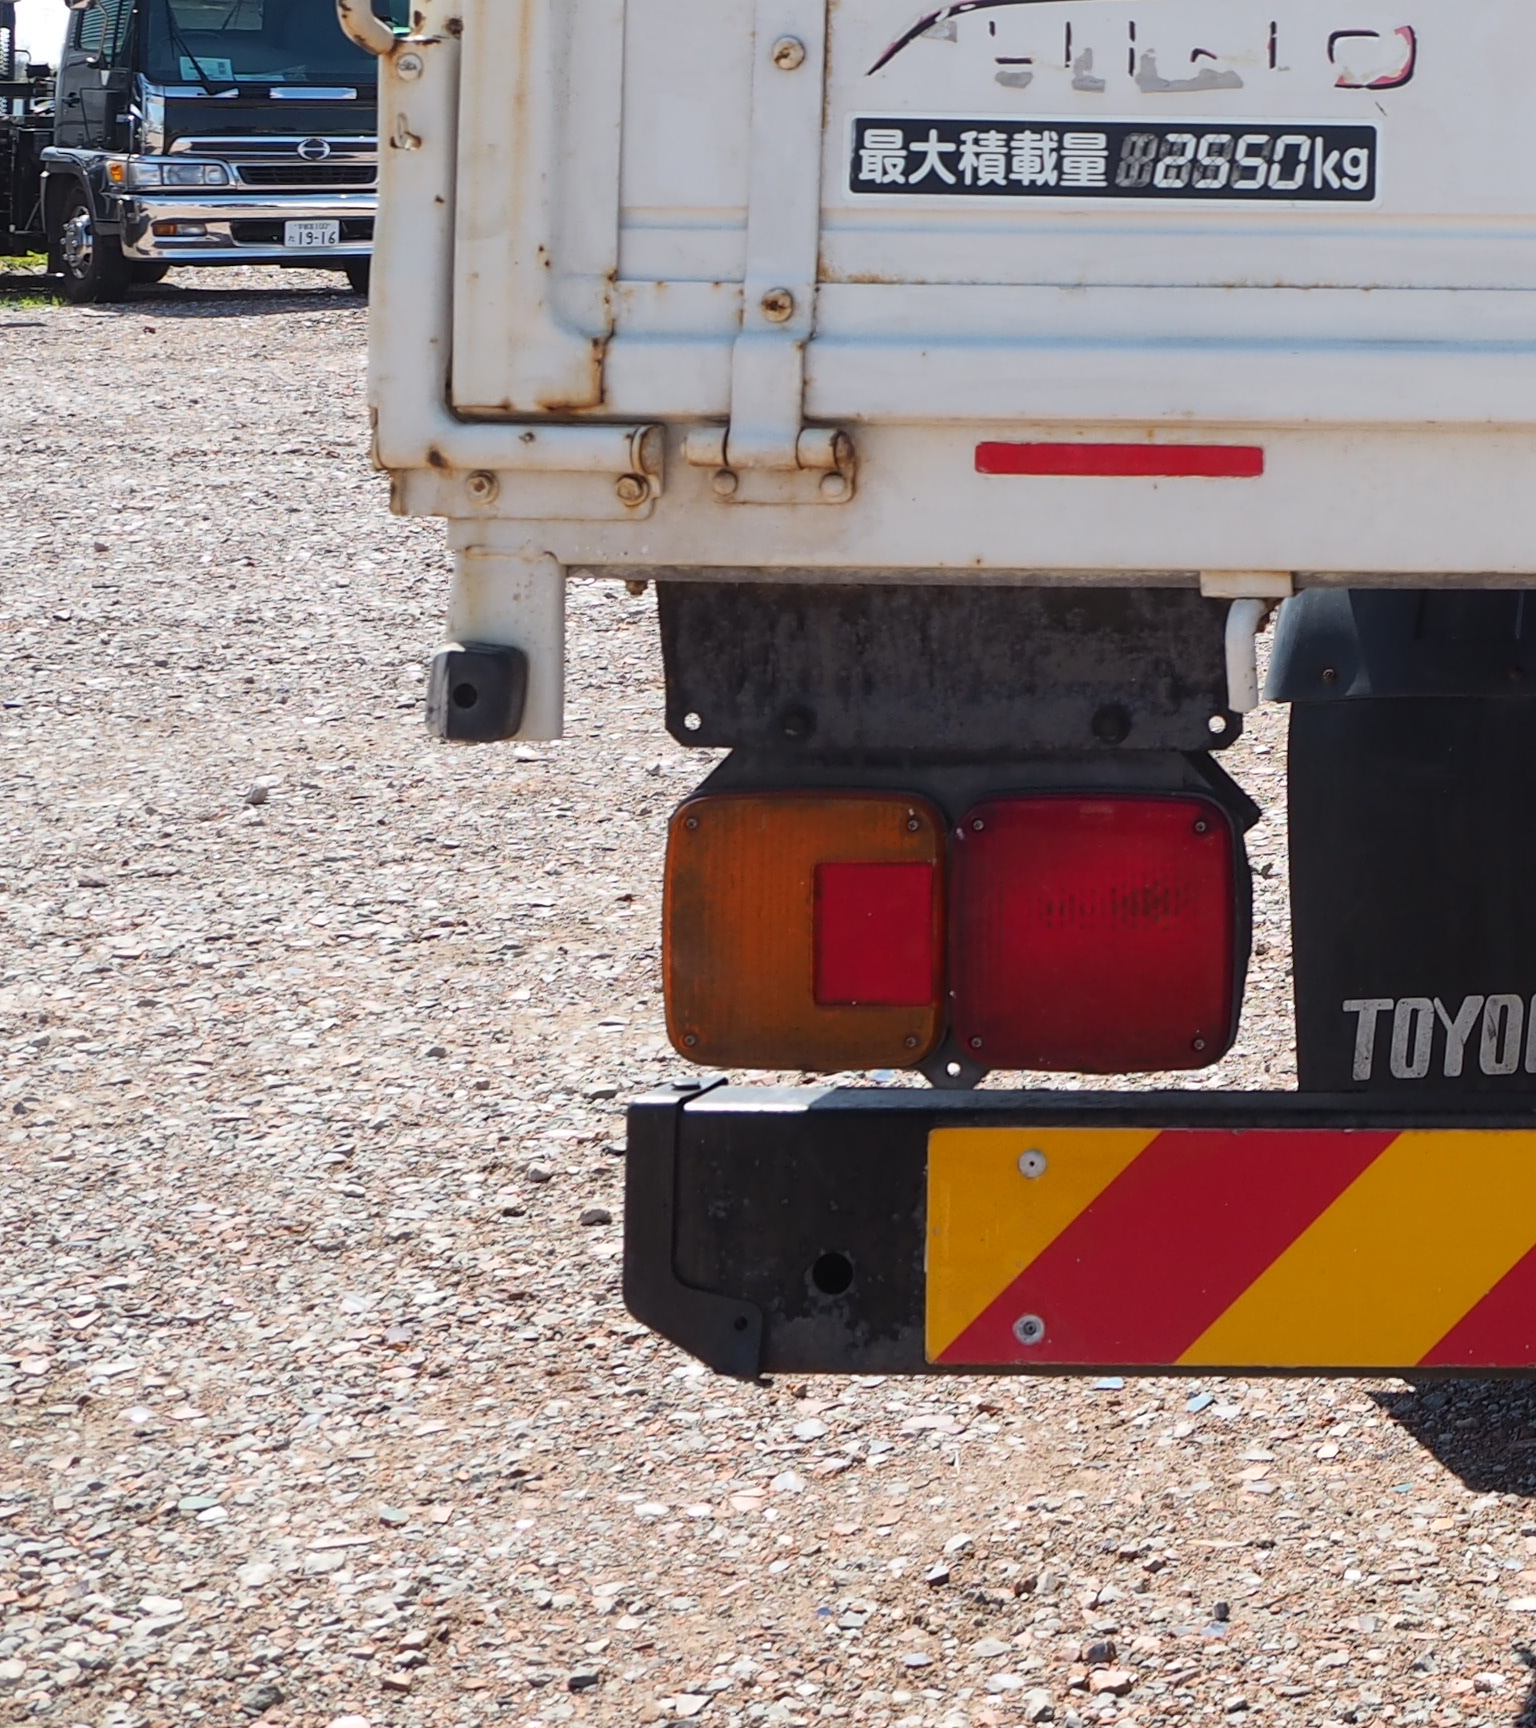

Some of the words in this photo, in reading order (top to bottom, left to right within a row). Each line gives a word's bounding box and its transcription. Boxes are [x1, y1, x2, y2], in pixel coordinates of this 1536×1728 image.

[858, 128, 1108, 187] 最大積載量
[299, 231, 336, 245] 19-16
